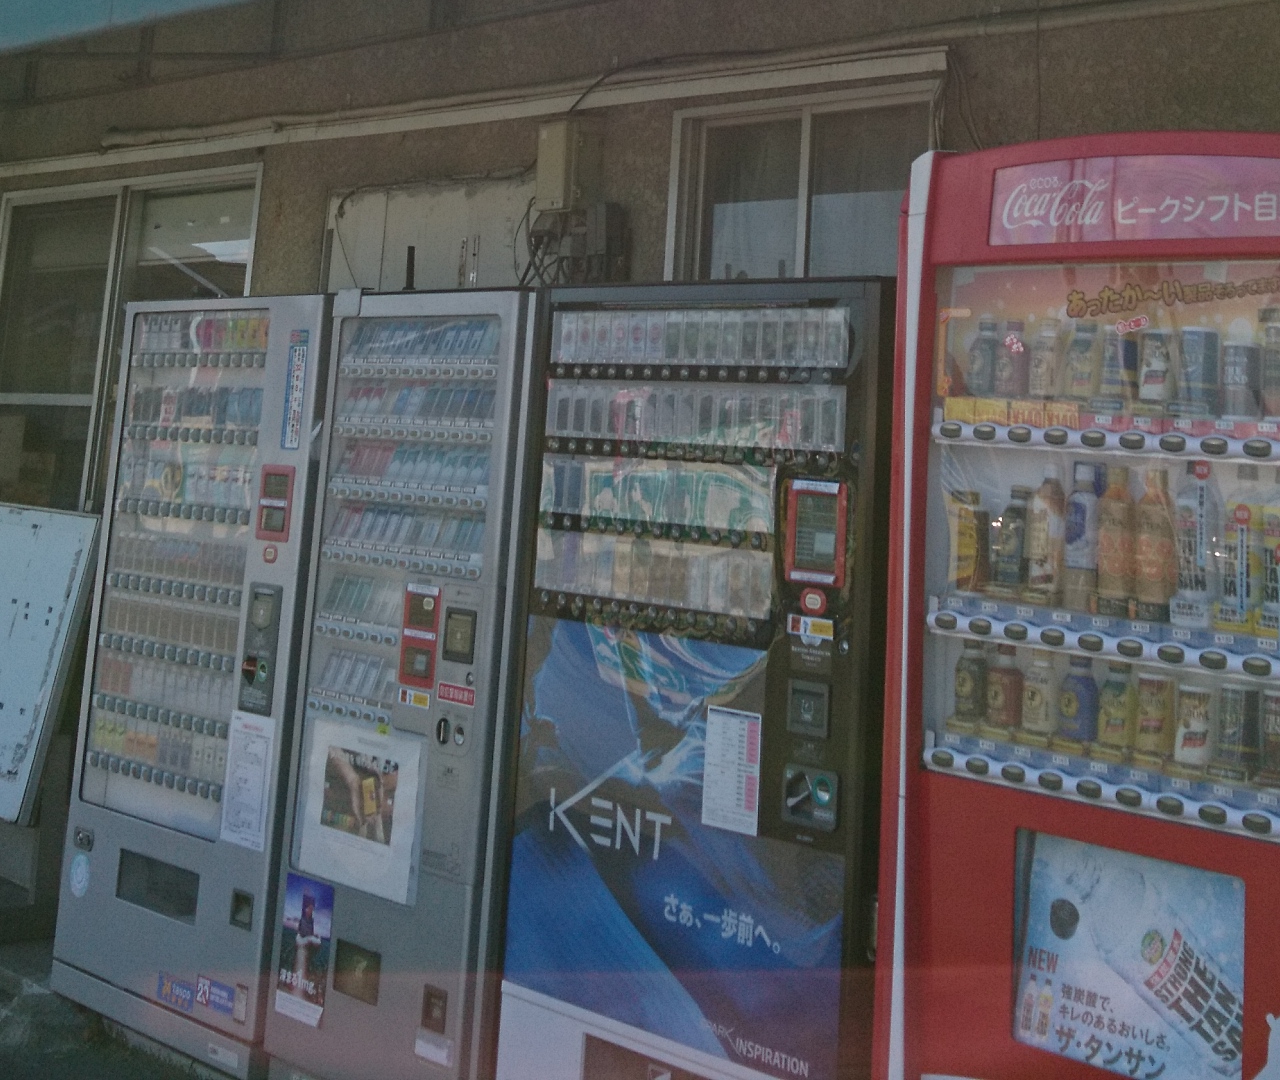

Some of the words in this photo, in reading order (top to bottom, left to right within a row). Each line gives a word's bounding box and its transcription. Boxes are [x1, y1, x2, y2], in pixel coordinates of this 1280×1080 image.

[1002, 179, 1110, 229] Coca-Cola
[549, 752, 672, 861] KENT
[1027, 948, 1060, 974] NEW
[735, 1037, 809, 1078] INSPIRATION
[1055, 1025, 1166, 1079] ザ・タンサン
